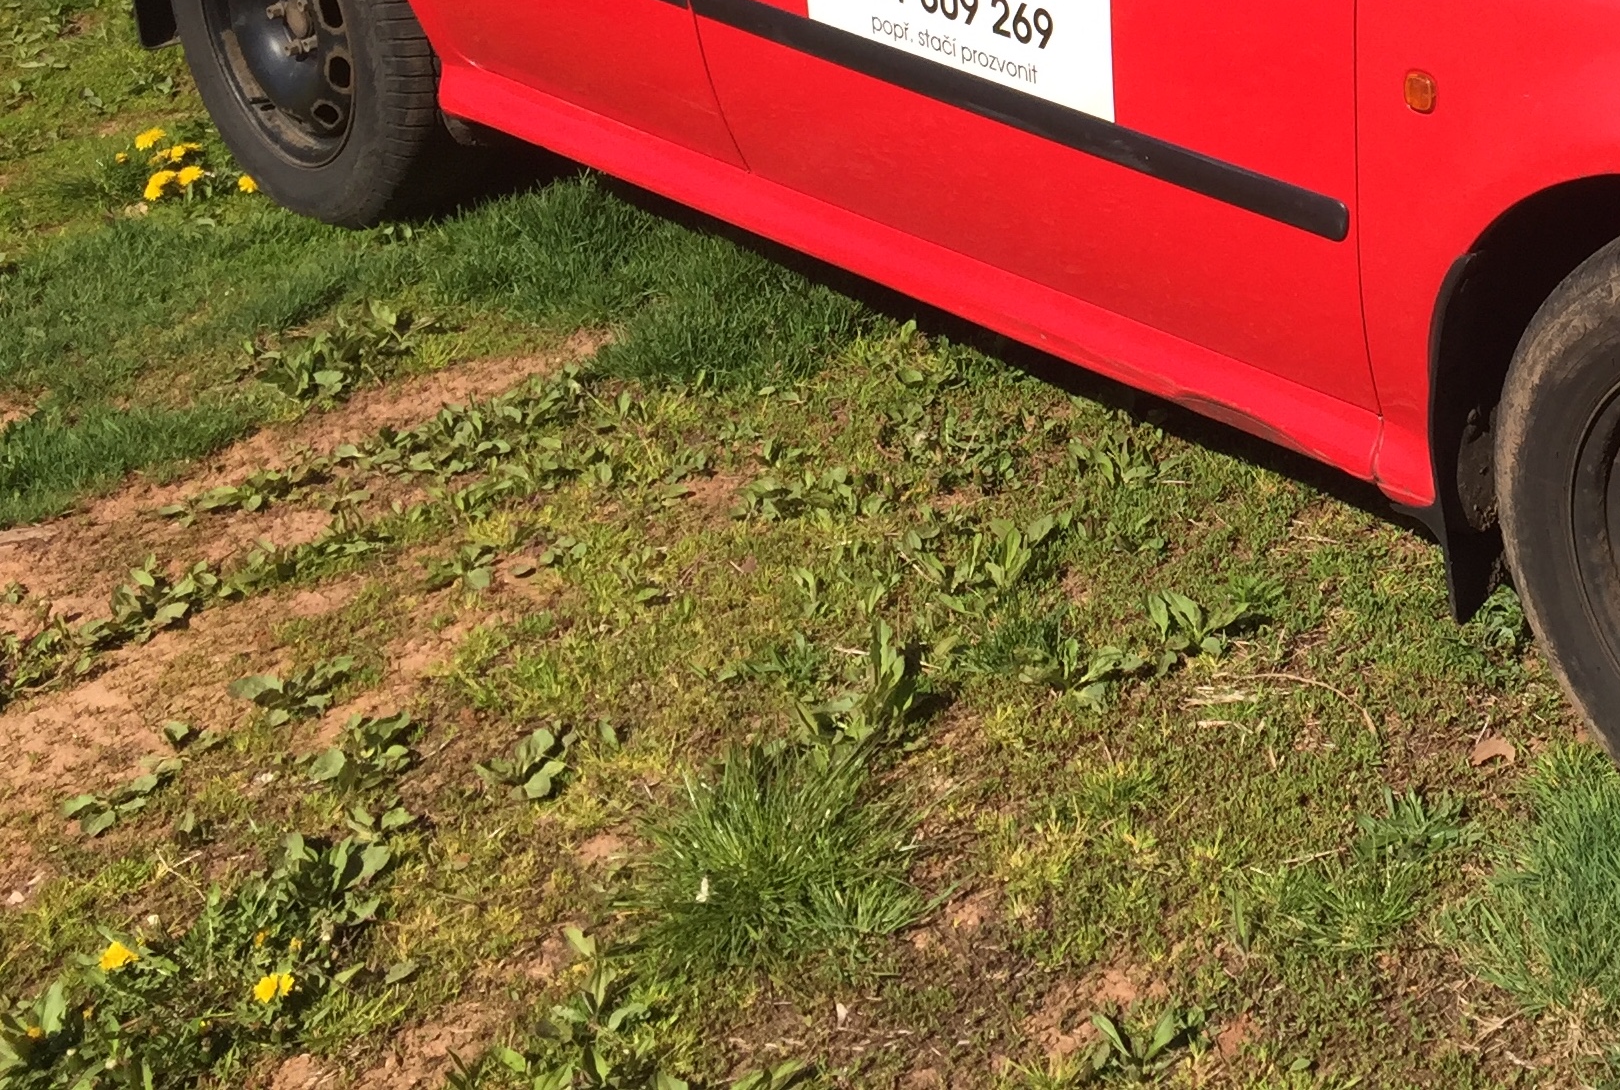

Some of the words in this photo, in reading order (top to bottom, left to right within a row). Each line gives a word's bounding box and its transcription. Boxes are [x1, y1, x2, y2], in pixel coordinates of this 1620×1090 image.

[871, 15, 914, 43] popř.
[918, 26, 957, 57] stačí
[961, 45, 1038, 84] prozvonit
